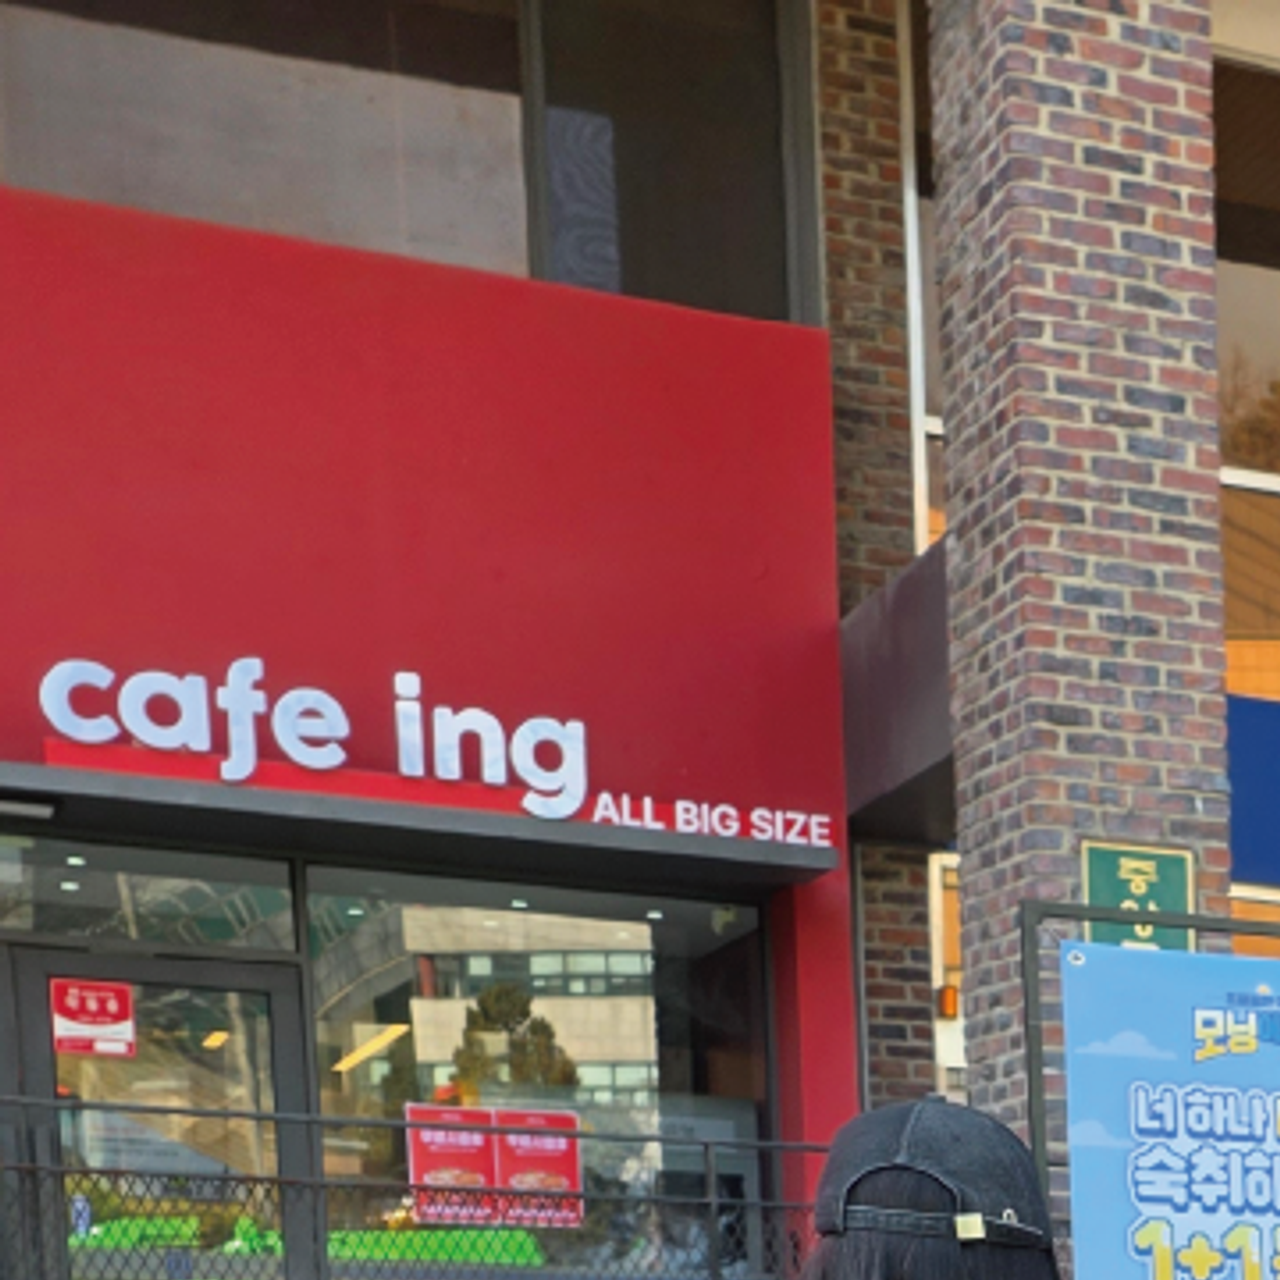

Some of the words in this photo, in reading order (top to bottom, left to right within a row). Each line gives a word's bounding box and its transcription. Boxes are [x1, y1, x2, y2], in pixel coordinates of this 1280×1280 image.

[39, 656, 350, 781] cafe
[394, 671, 588, 820] ing
[592, 793, 664, 831] ALL
[675, 800, 740, 838] BIG
[750, 807, 831, 846] SIZE
[1134, 1086, 1177, 1139] 너
[1184, 1087, 1268, 1142] 하나
